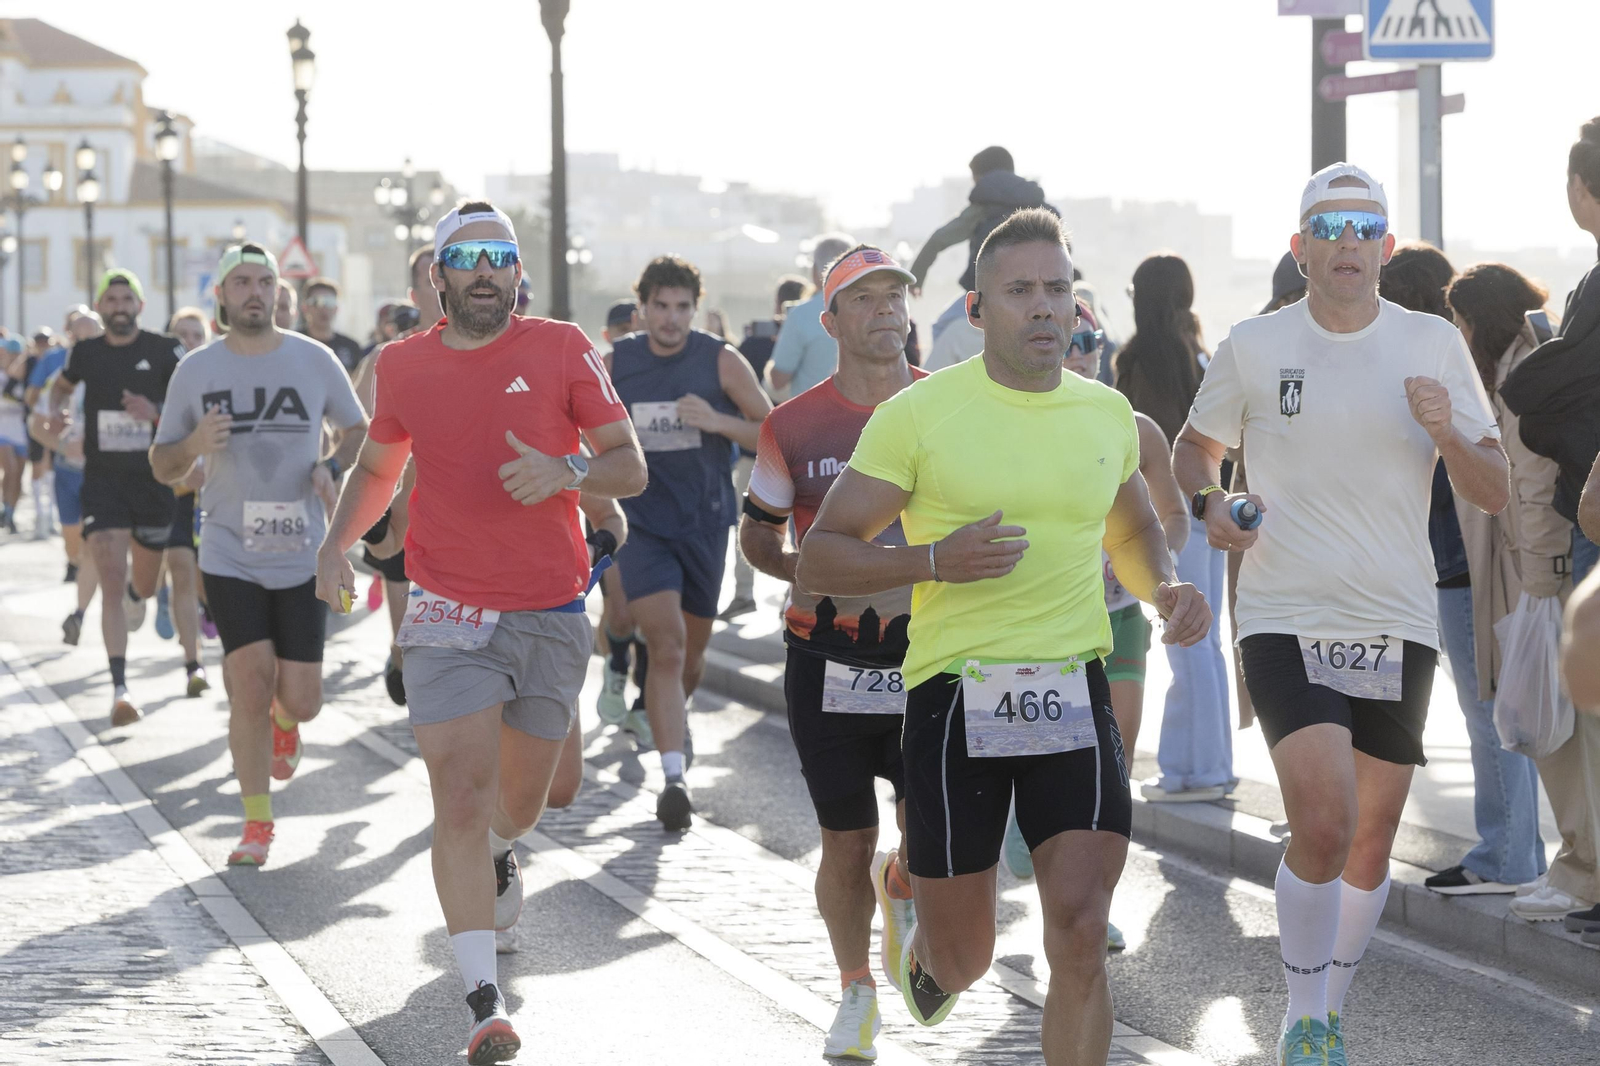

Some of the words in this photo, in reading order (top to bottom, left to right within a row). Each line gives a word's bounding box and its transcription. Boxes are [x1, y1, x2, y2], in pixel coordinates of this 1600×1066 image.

[648, 417, 683, 433] 484
[254, 516, 305, 536] 2189
[411, 600, 483, 629] 2544
[1310, 640, 1388, 672] 1627
[848, 667, 904, 693] 728
[993, 689, 1063, 724] 466
